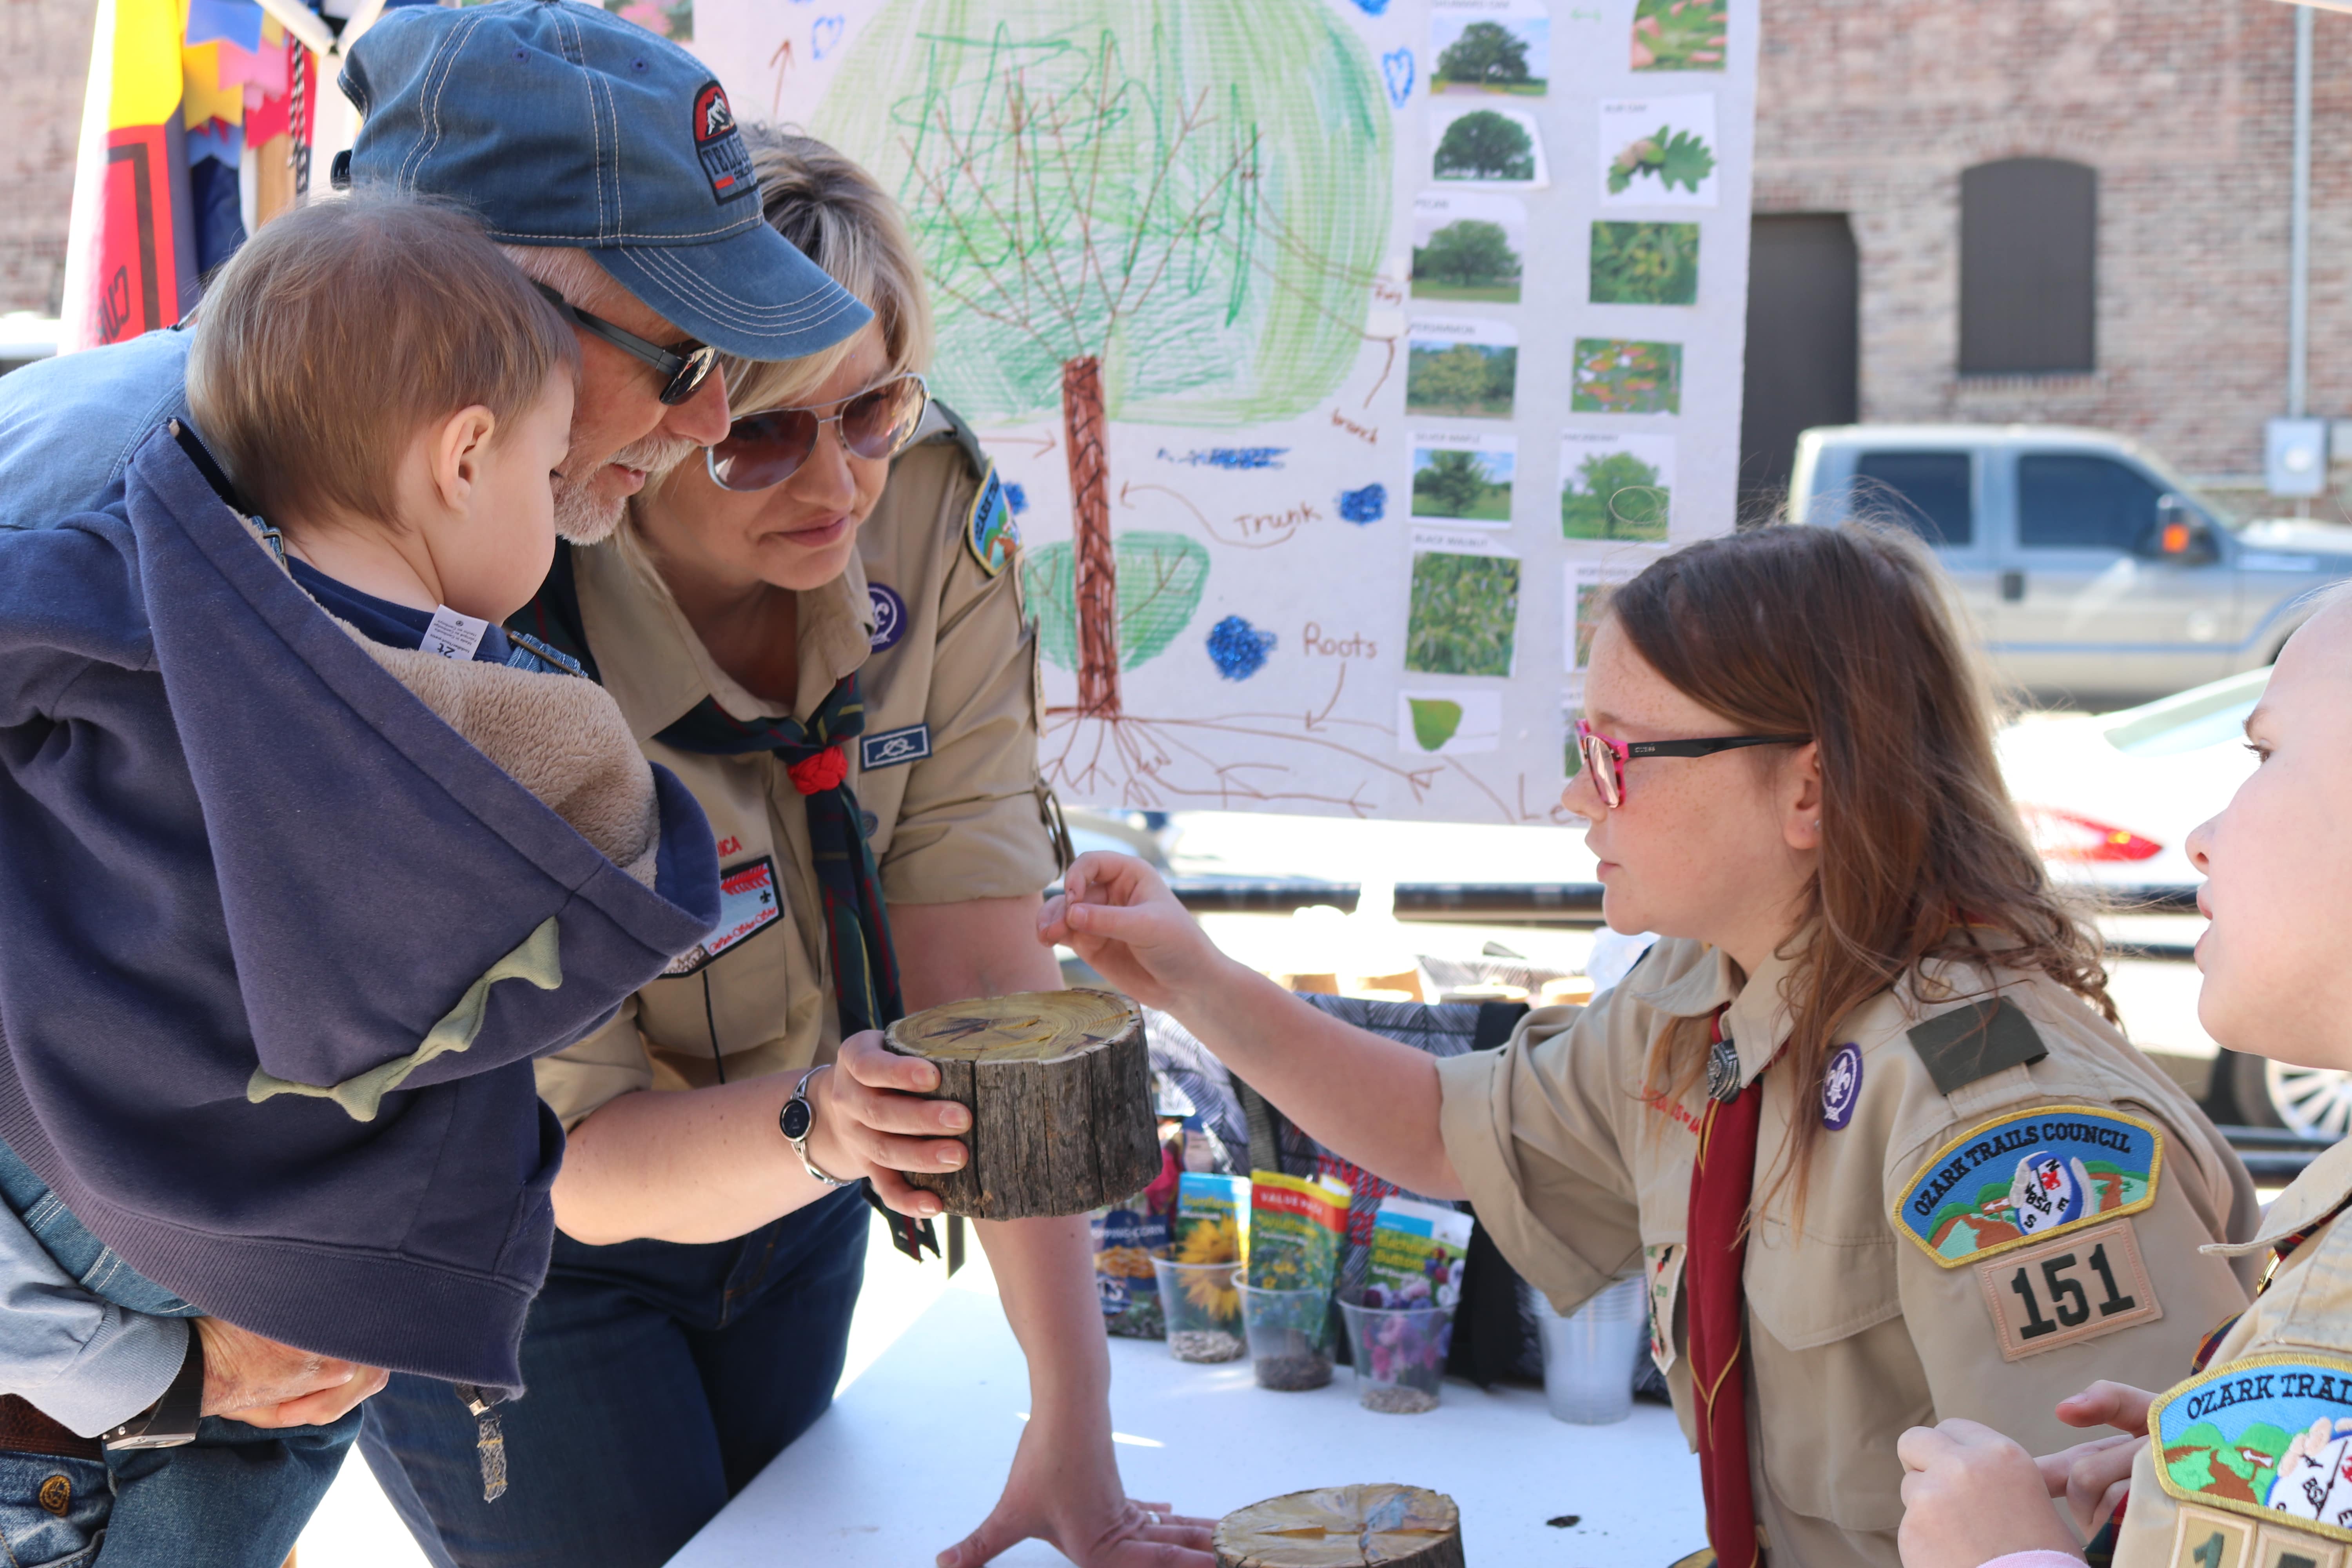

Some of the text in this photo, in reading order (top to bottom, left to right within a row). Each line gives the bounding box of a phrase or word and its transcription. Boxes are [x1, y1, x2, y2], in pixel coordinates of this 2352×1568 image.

[1302, 621, 1377, 659] Roots
[1914, 1123, 2131, 1216] OZARK TRAILS COUNCIL
[2026, 1191, 2053, 1215] BSA
[2011, 1243, 2136, 1340] 151
[2187, 1373, 2352, 1419] OZARK TRAI
